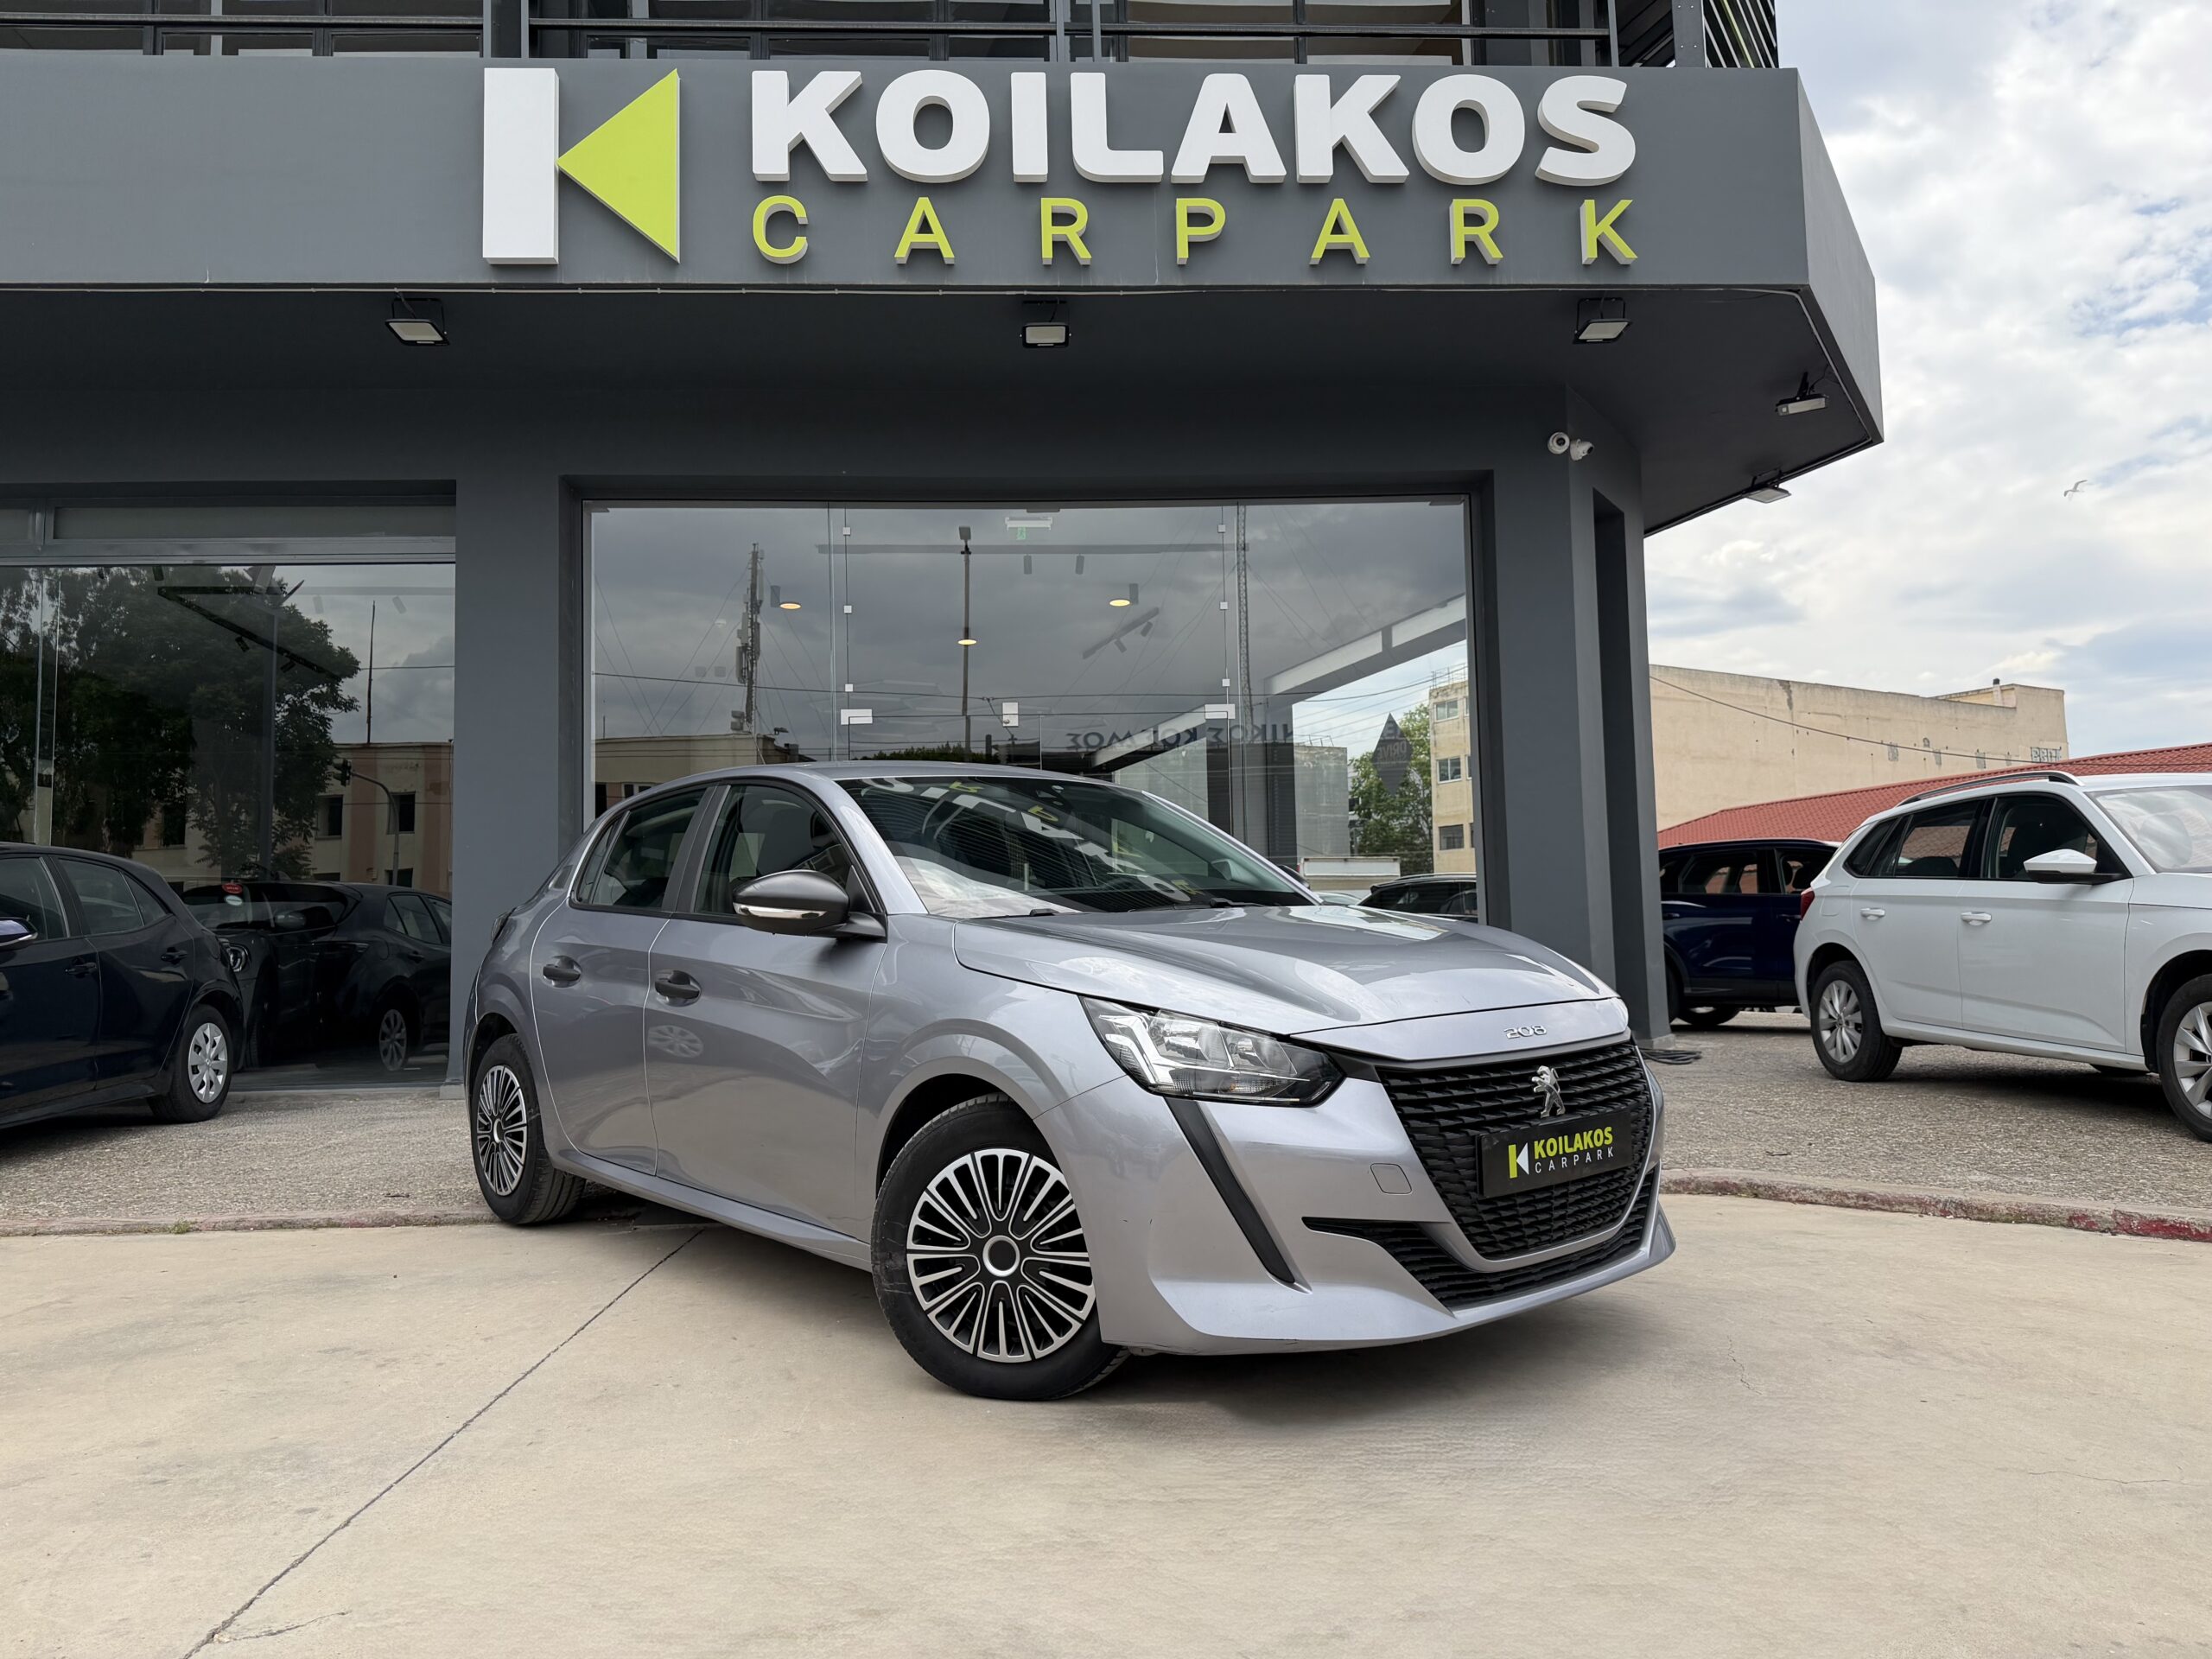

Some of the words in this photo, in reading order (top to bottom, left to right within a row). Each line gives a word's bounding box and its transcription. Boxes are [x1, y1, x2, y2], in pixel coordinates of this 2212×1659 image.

[751, 70, 1637, 186] KOILAKOS
[753, 195, 1638, 264] CARPARK
[1503, 1024, 1547, 1039] 208
[1534, 1126, 1613, 1160] KOILAKOS
[1535, 1146, 1614, 1173] CARPARK
